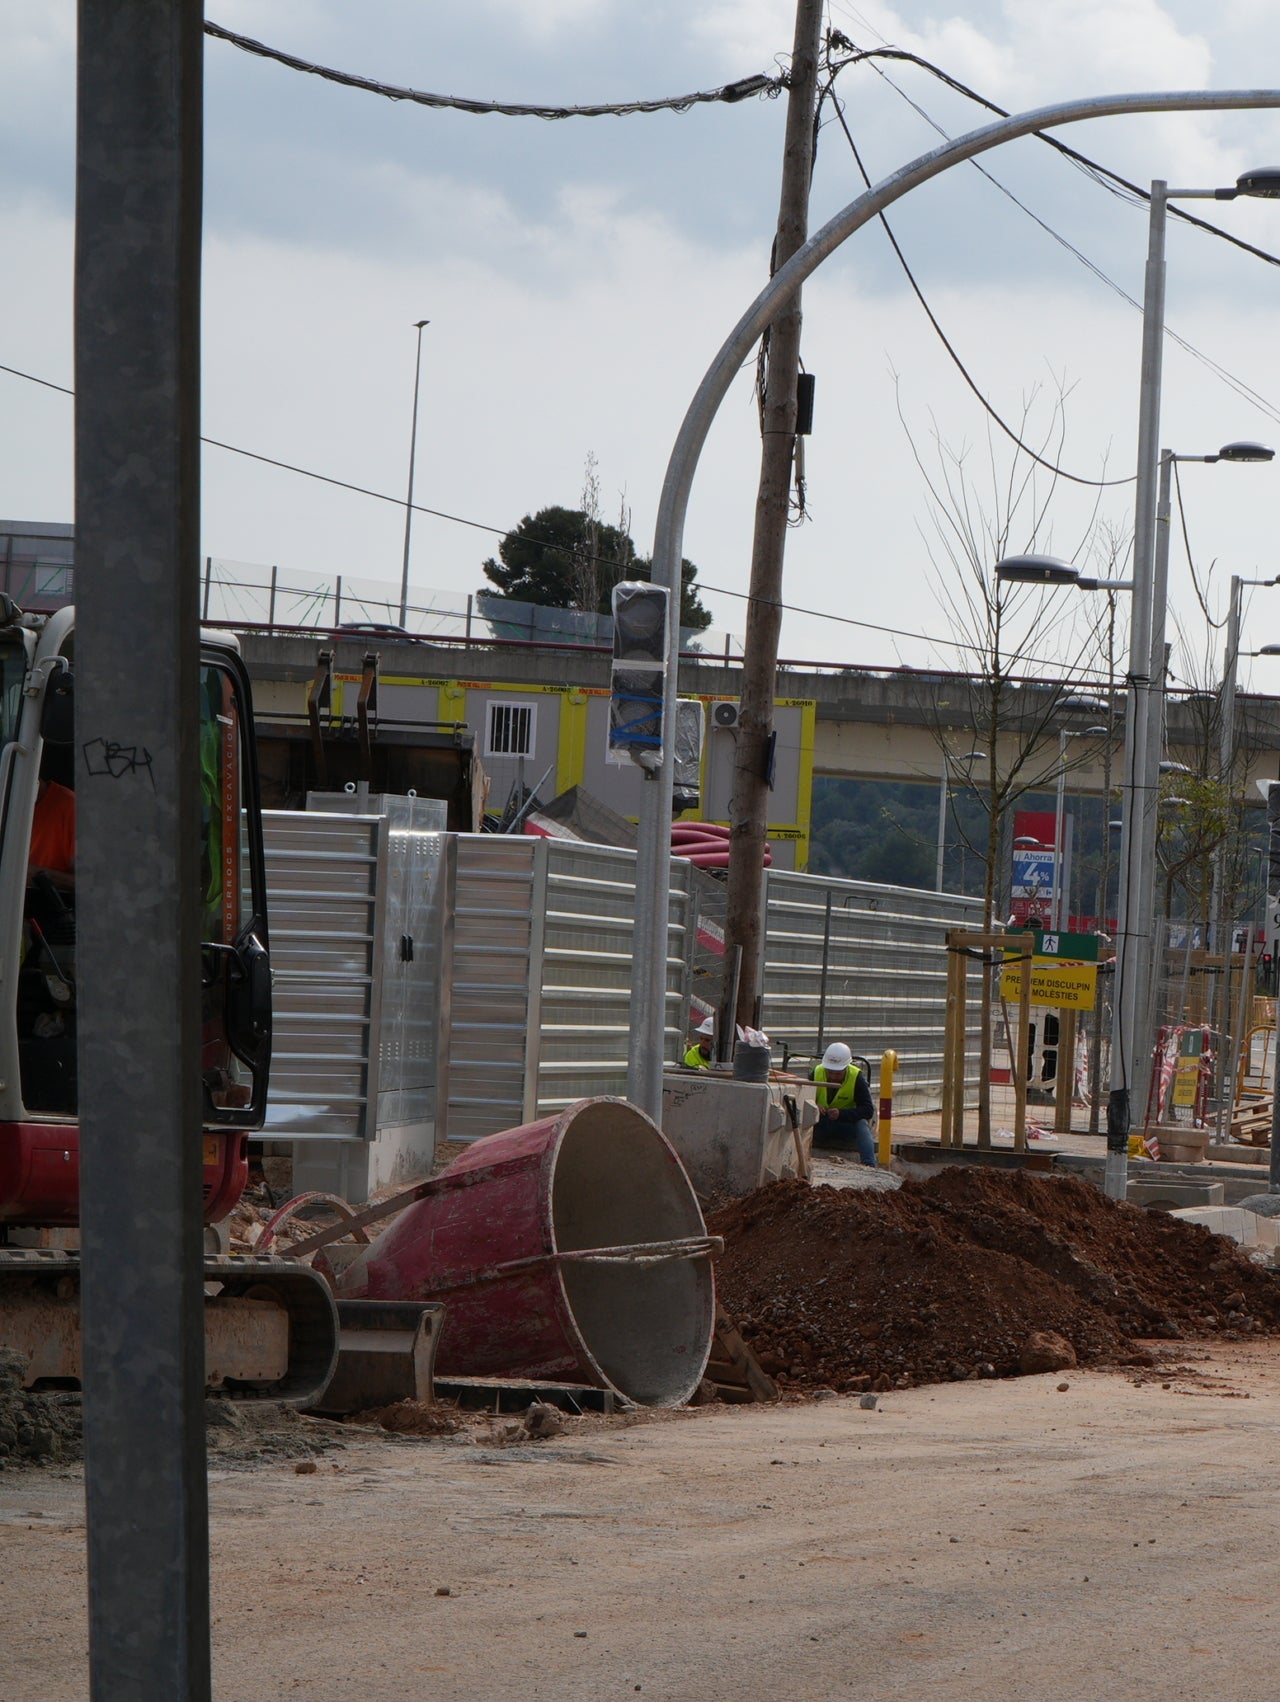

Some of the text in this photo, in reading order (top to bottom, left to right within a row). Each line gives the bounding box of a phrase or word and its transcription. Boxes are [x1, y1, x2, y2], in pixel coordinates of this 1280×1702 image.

[1023, 853, 1053, 862] Ahorra
[1005, 975, 1090, 991] PREEM DISCULPIN
